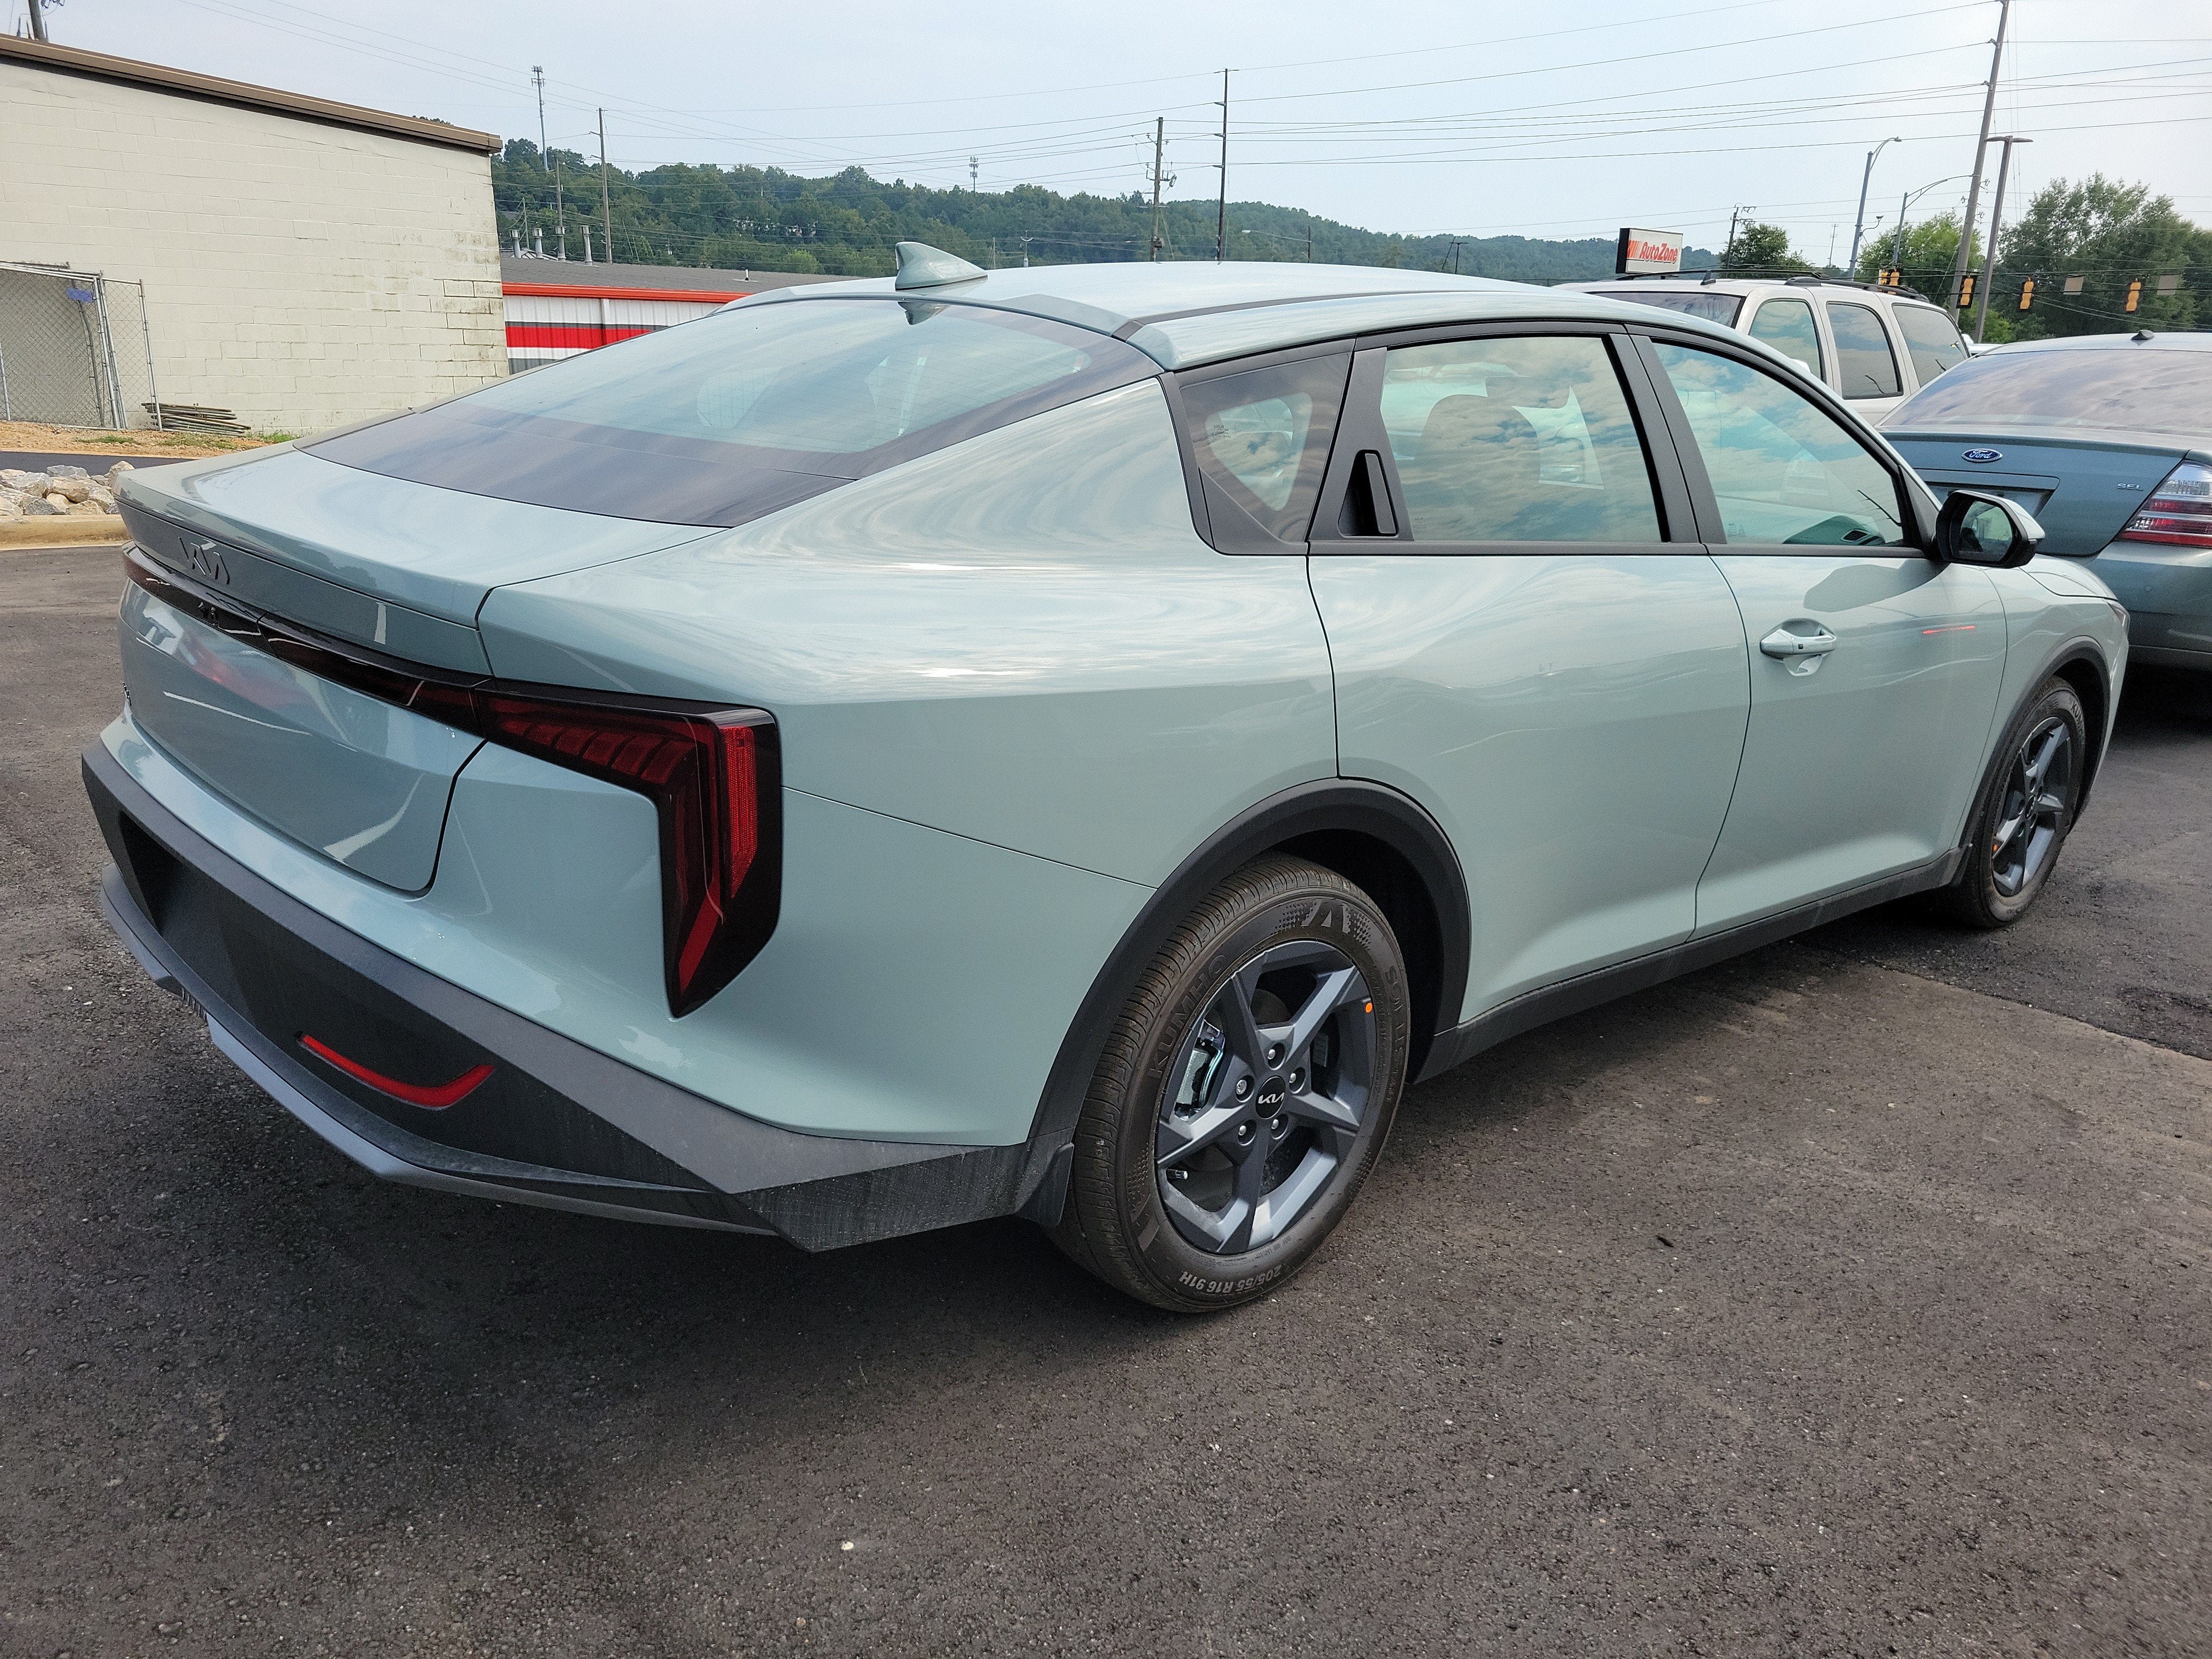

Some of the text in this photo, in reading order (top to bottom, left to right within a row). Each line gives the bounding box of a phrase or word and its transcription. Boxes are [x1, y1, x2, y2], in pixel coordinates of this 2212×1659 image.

[1639, 241, 1678, 262] AutoZone
[1969, 449, 1993, 459] Ford
[1148, 955, 1226, 1078] KUMHO
[1257, 1092, 1285, 1104] KIA
[1180, 1265, 1282, 1293] 205/55 R16 91H
